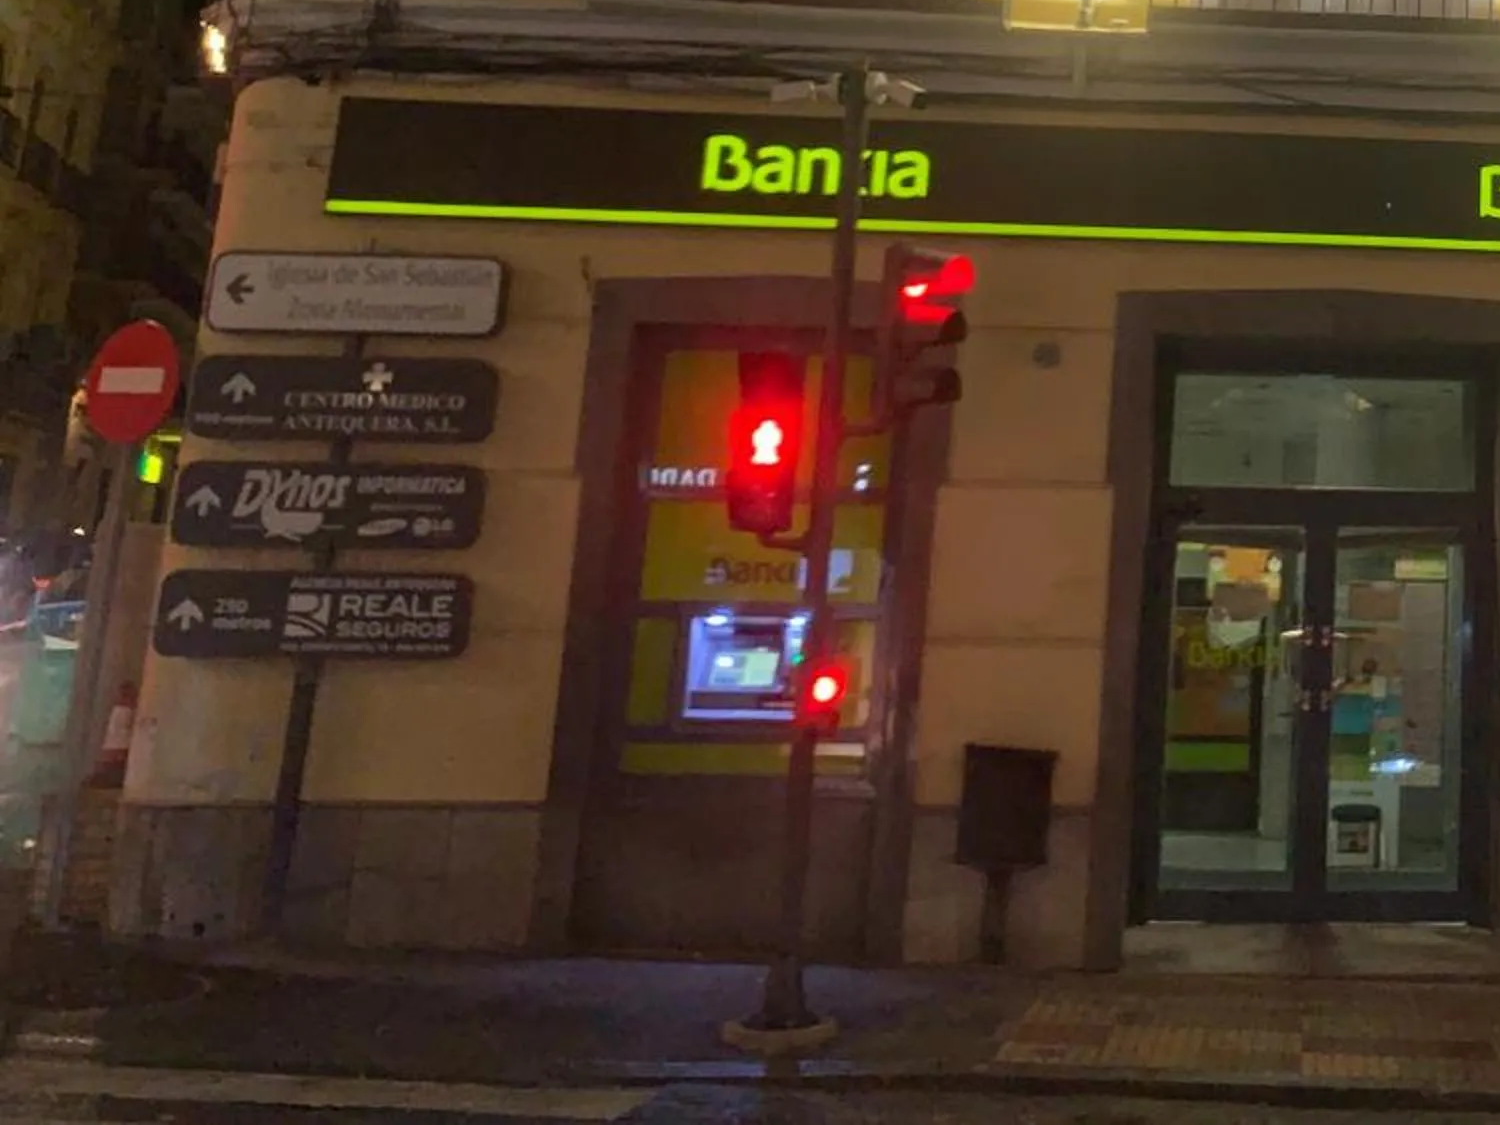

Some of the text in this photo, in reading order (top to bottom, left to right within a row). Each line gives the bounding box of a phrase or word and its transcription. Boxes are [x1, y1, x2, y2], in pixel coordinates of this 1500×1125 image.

[702, 134, 930, 198] Bania
[283, 391, 374, 408] CENTRO
[338, 592, 454, 618] REALE
[335, 620, 451, 639] SEGUROS
